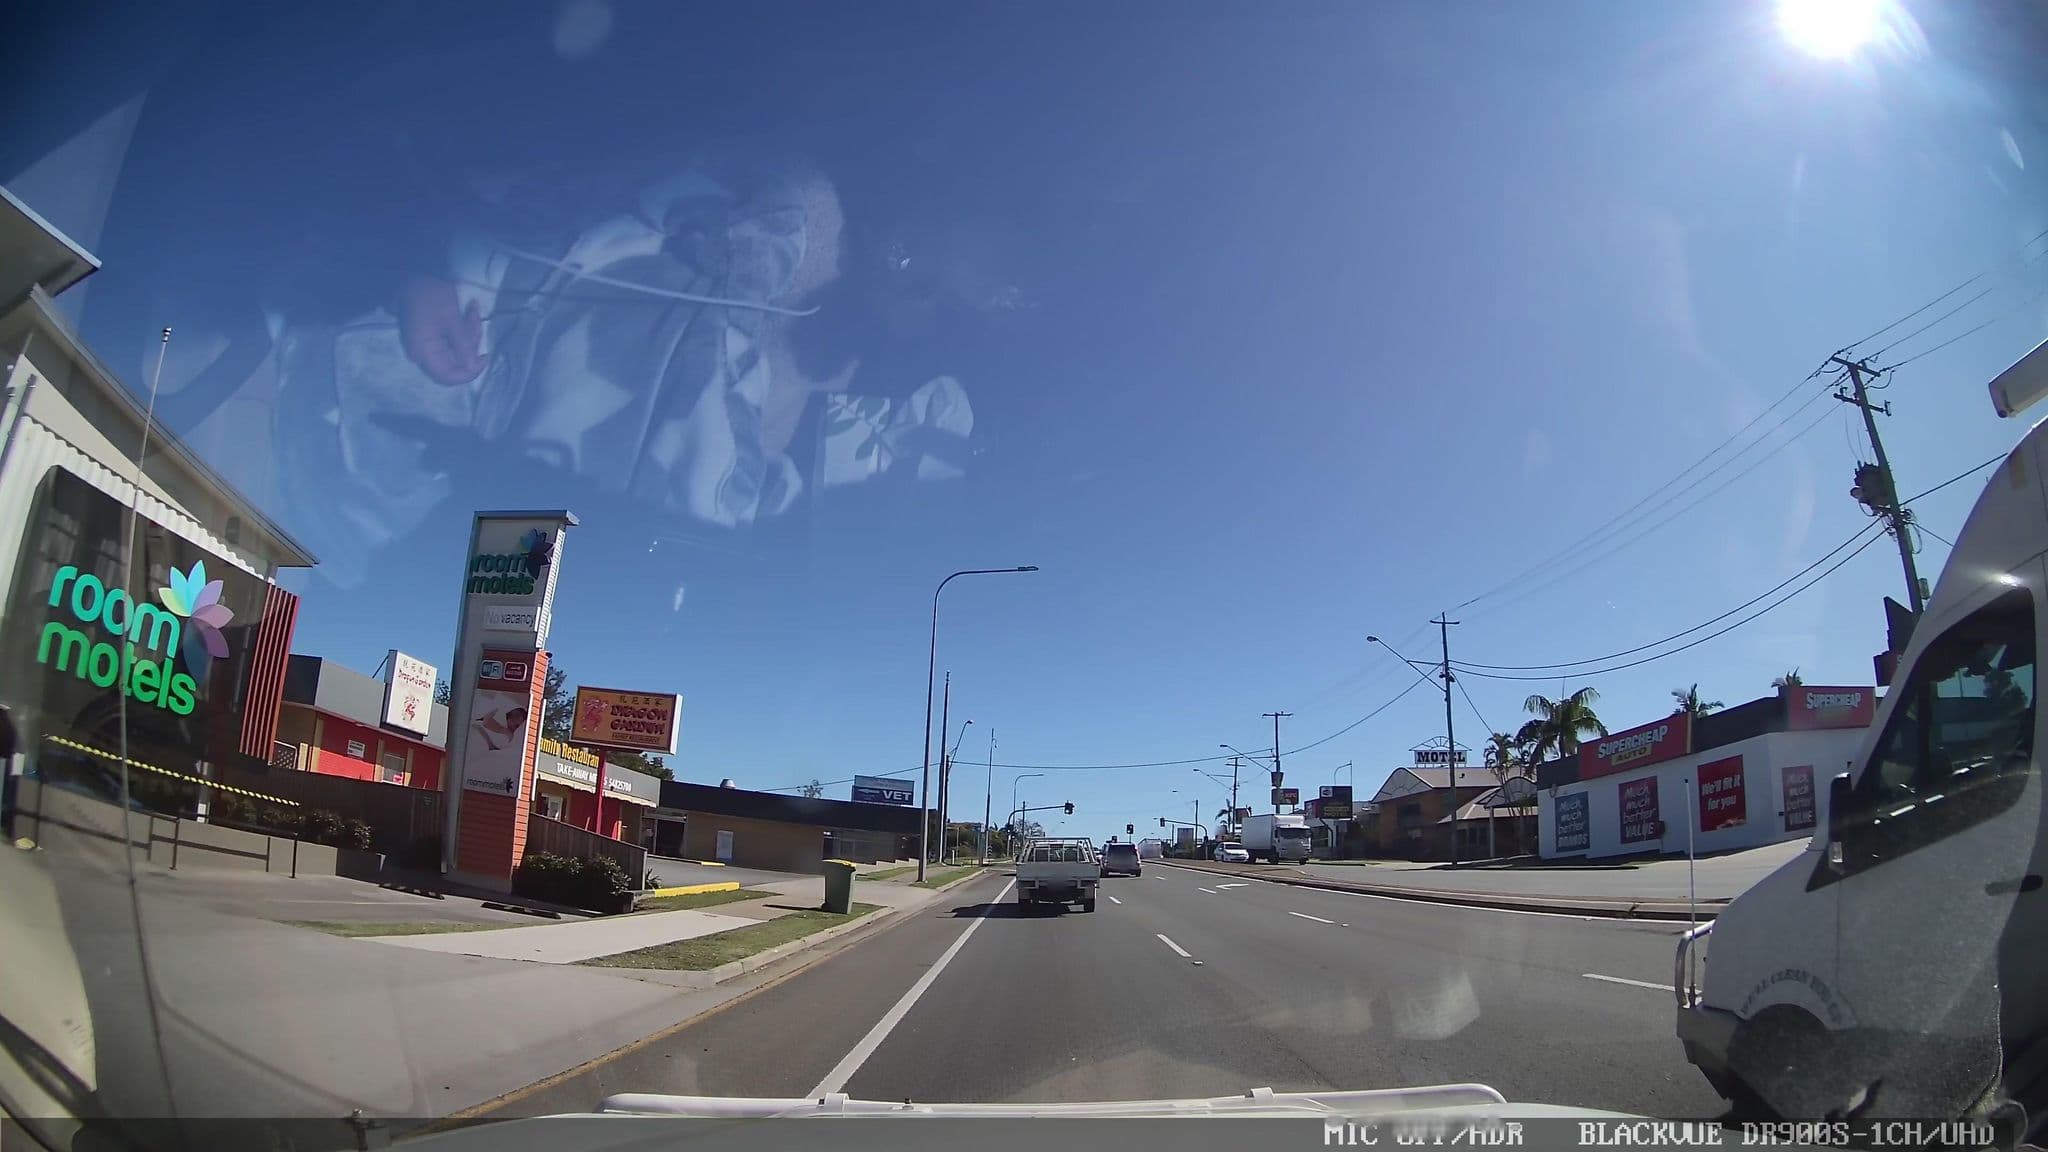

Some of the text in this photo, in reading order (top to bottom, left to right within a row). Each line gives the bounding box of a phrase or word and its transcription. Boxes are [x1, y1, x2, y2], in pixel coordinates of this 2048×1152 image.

[472, 553, 528, 573] room
[467, 573, 534, 595] motels
[48, 565, 181, 658] room
[501, 614, 536, 628] vacancy
[37, 621, 196, 715] motels
[1806, 692, 1861, 709] SUPERCHEAP
[610, 705, 668, 721] DRAGON
[1598, 725, 1668, 759] SUPERCHEAP
[561, 742, 600, 768] Restauran
[1615, 747, 1647, 763] AUTO
[882, 790, 912, 801] VET
[1708, 795, 1737, 811] for you
[1626, 821, 1655, 839] VALUE
